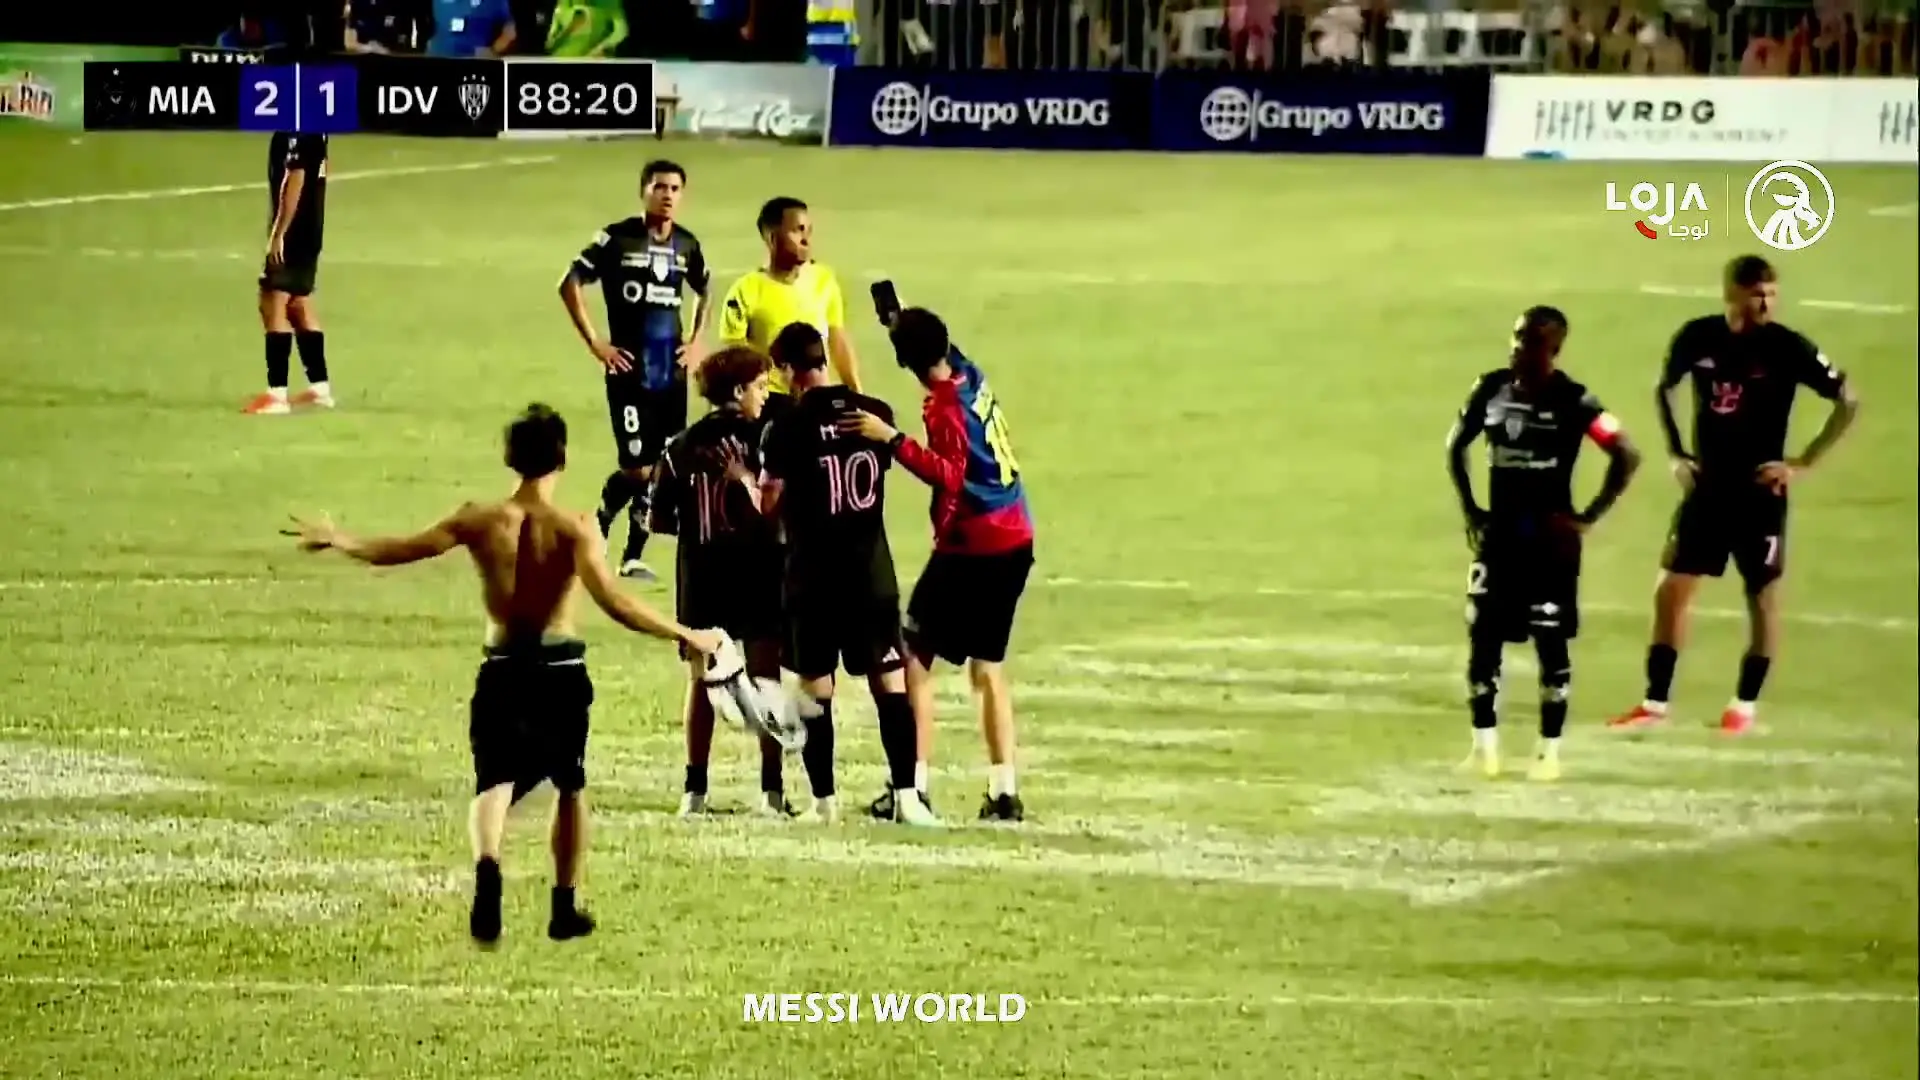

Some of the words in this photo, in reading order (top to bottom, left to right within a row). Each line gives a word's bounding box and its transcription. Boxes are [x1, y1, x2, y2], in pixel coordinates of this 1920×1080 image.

[929, 95, 1018, 131] Grupo
[1025, 97, 1110, 126] VRDG
[1258, 100, 1350, 135] Grupo
[1357, 102, 1445, 131] VRDG
[1606, 99, 1715, 125] VRDG
[1603, 127, 1788, 143] ENTERANMENT
[623, 405, 640, 433] 8
[819, 449, 879, 516] 10
[1764, 535, 1779, 565] 7
